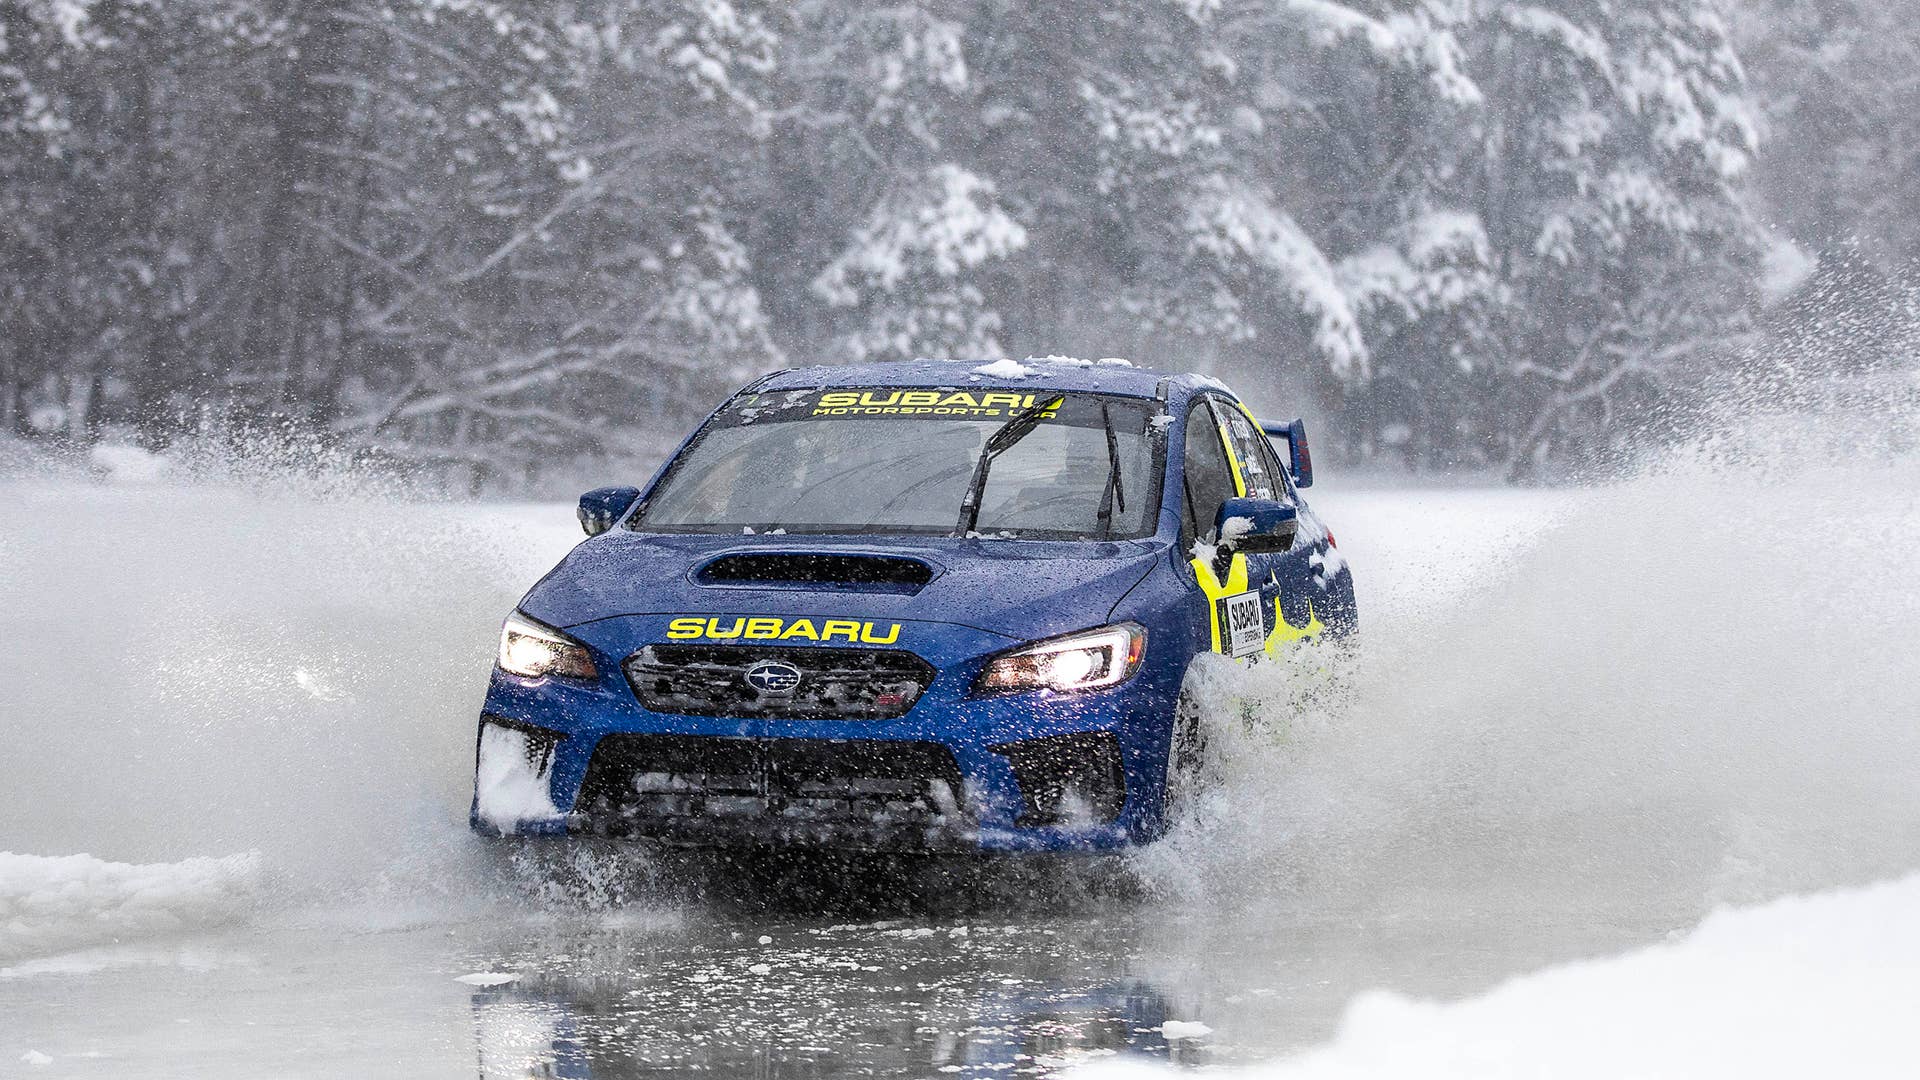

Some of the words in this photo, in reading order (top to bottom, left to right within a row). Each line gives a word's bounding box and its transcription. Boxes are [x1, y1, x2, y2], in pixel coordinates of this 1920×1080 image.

[812, 407, 1000, 416] MOTORSPORTS
[1008, 410, 1056, 419] UA
[1231, 598, 1260, 632] SUBARU
[667, 617, 901, 644] SUBARU
